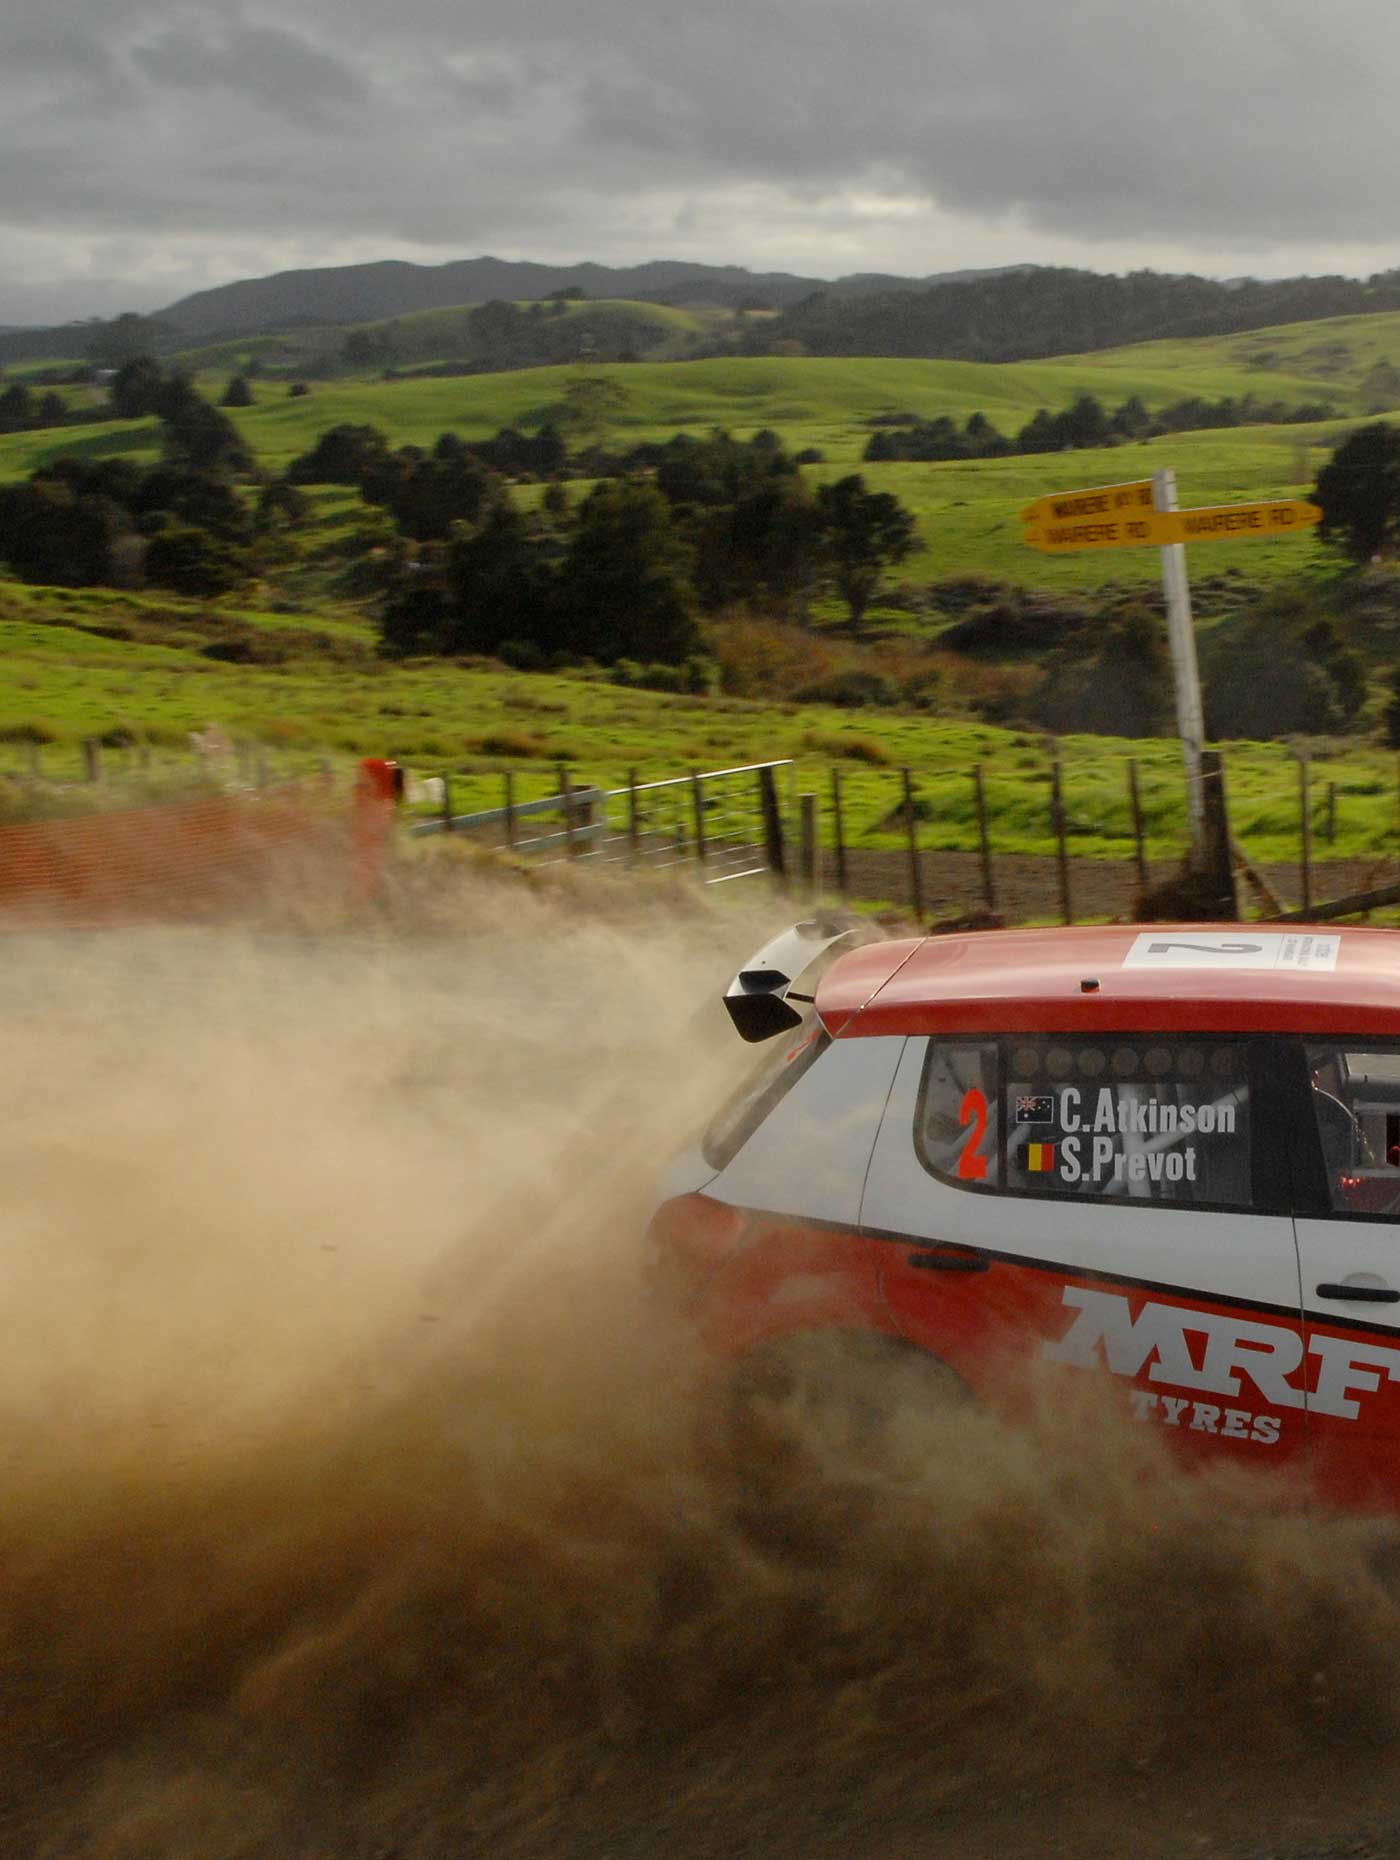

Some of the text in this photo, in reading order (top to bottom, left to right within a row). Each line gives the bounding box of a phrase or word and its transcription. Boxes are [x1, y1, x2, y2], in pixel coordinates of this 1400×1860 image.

[1147, 942, 1263, 954] 2
[959, 1087, 988, 1180] 2
[1130, 1389, 1282, 1445] TYRES
